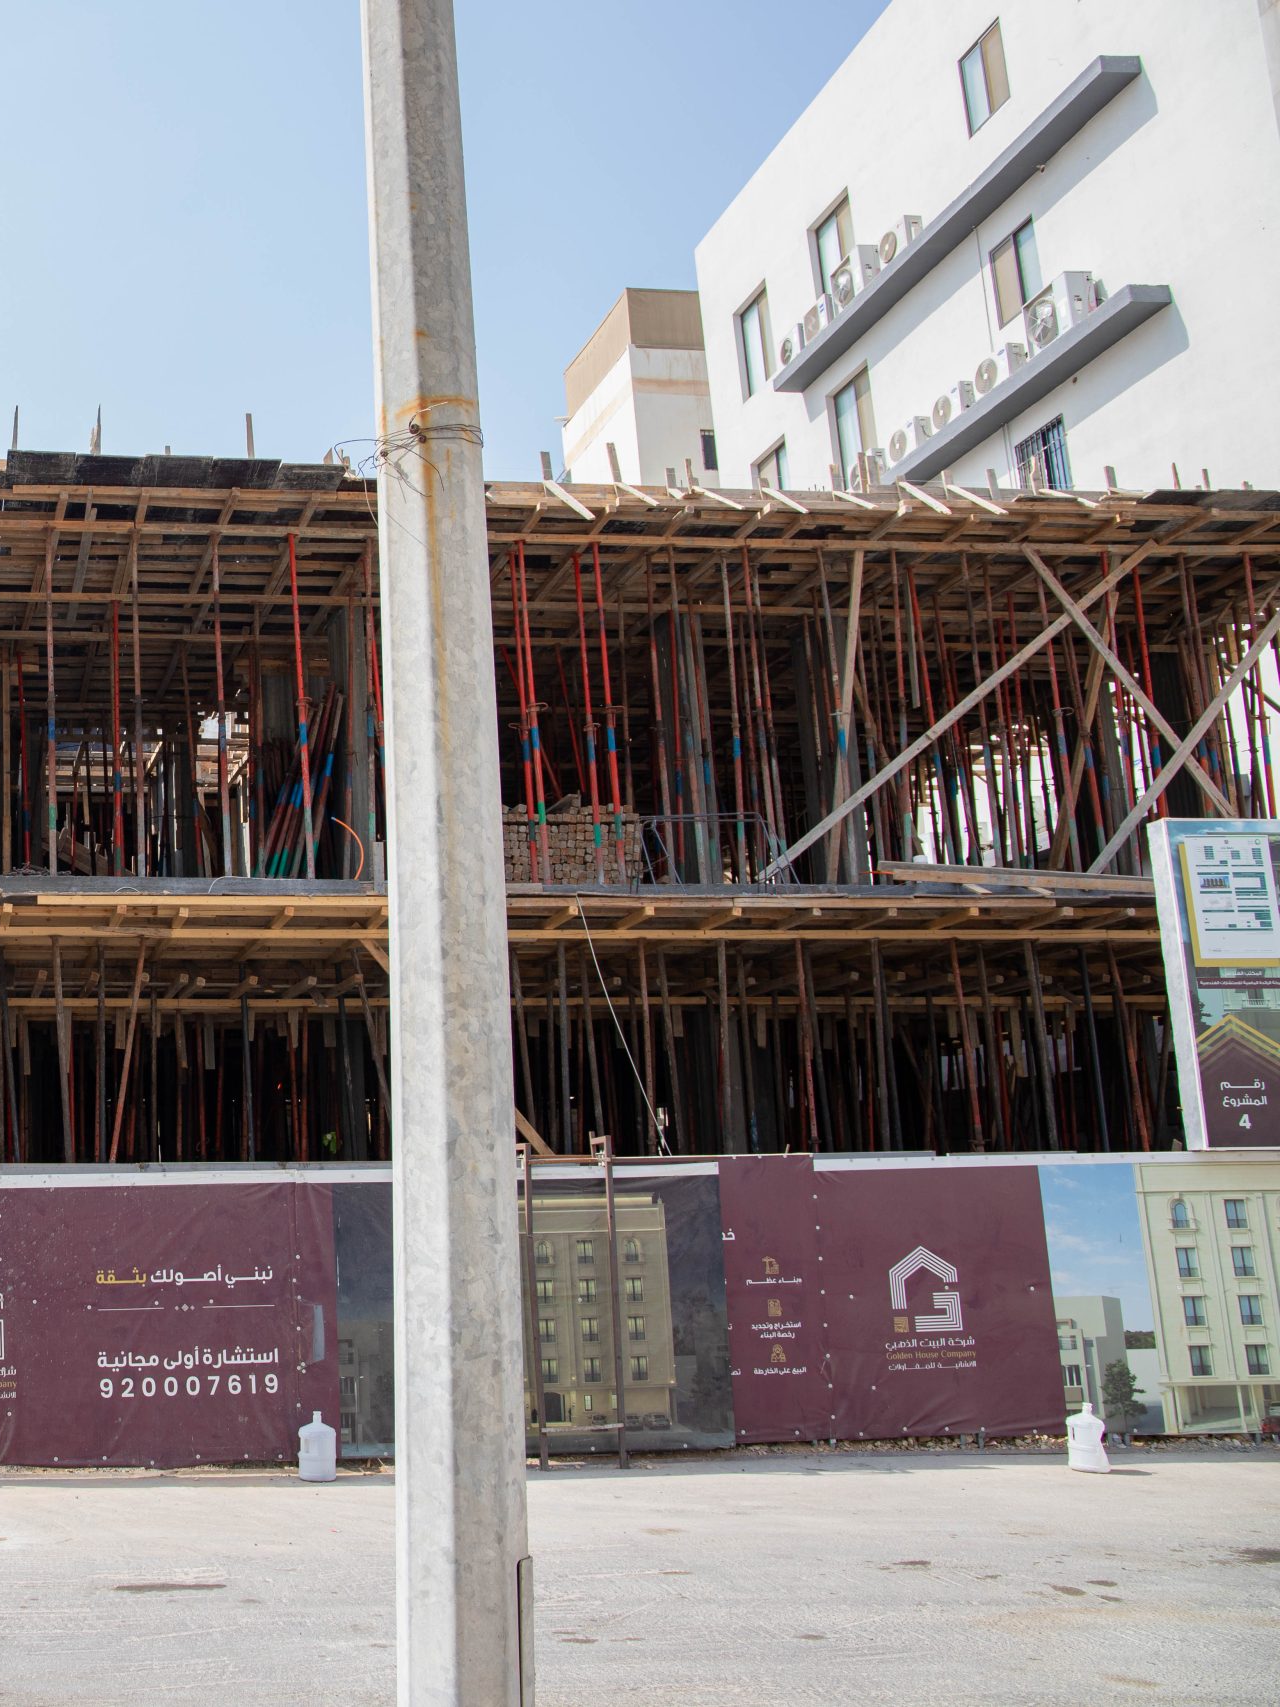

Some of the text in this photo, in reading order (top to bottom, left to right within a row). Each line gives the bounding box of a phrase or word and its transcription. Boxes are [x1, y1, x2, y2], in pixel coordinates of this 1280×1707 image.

[1220, 1079, 1265, 1091] رقم
[1222, 1094, 1268, 1107] المشروع
[1239, 1114, 1252, 1129] 4
[95, 1264, 273, 1288] نبني أصولك بثقة
[774, 1321, 802, 1330] استخراج
[885, 1336, 975, 1351] شركة البيت الذهبي
[97, 1346, 280, 1372] استشارة أولى مجانية
[886, 1349, 976, 1360] Golden House Company
[753, 1366, 779, 1376] الخارطة
[792, 1366, 807, 1375] البيع
[99, 1373, 280, 1399] 920007619
